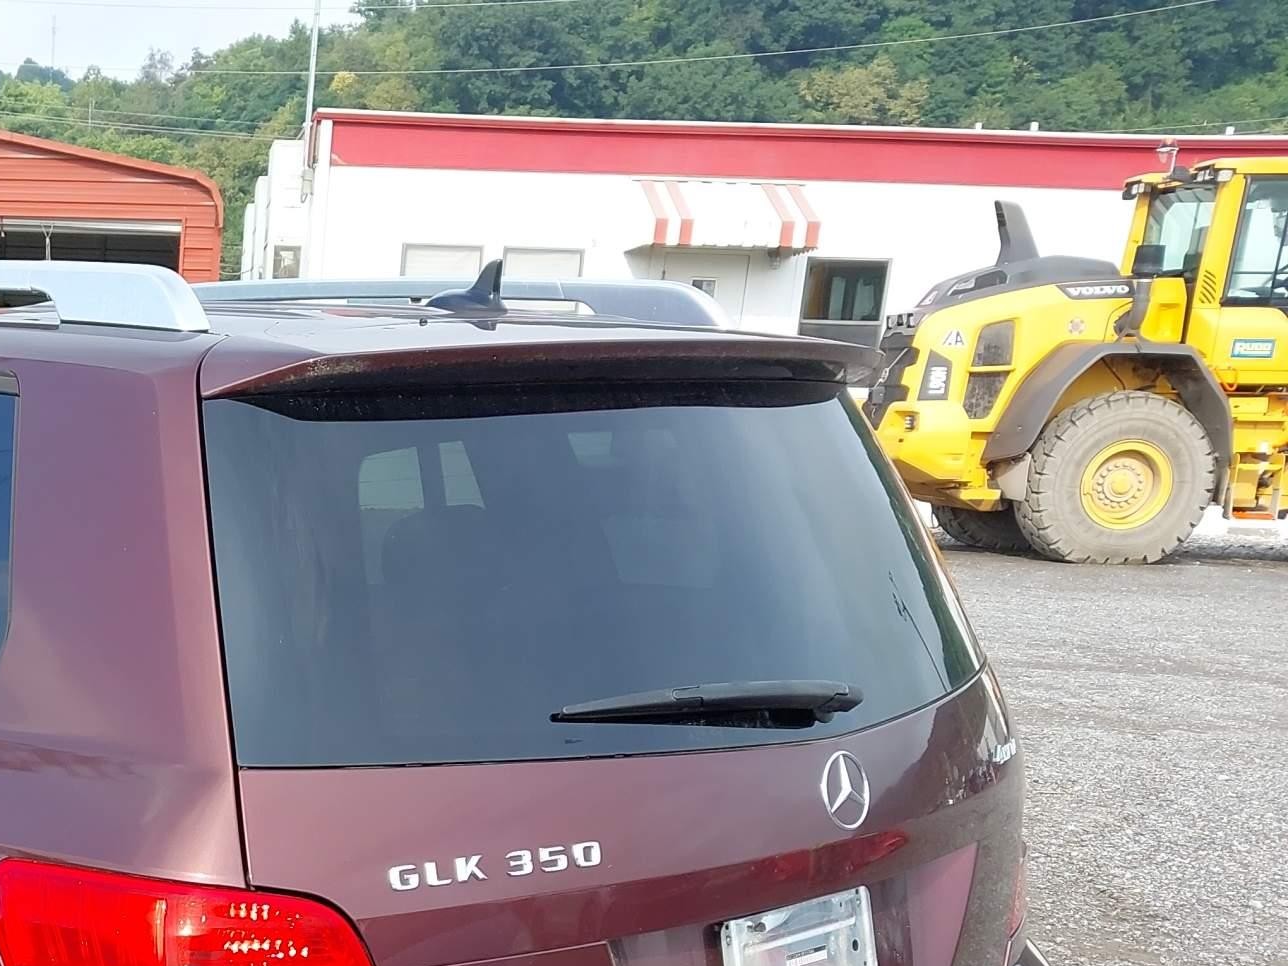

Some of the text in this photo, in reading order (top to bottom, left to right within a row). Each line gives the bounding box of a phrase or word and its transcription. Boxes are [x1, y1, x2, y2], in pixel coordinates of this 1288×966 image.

[1065, 284, 1130, 296] VOLVO
[927, 366, 948, 394] L90H
[388, 840, 602, 892] GLK 350
